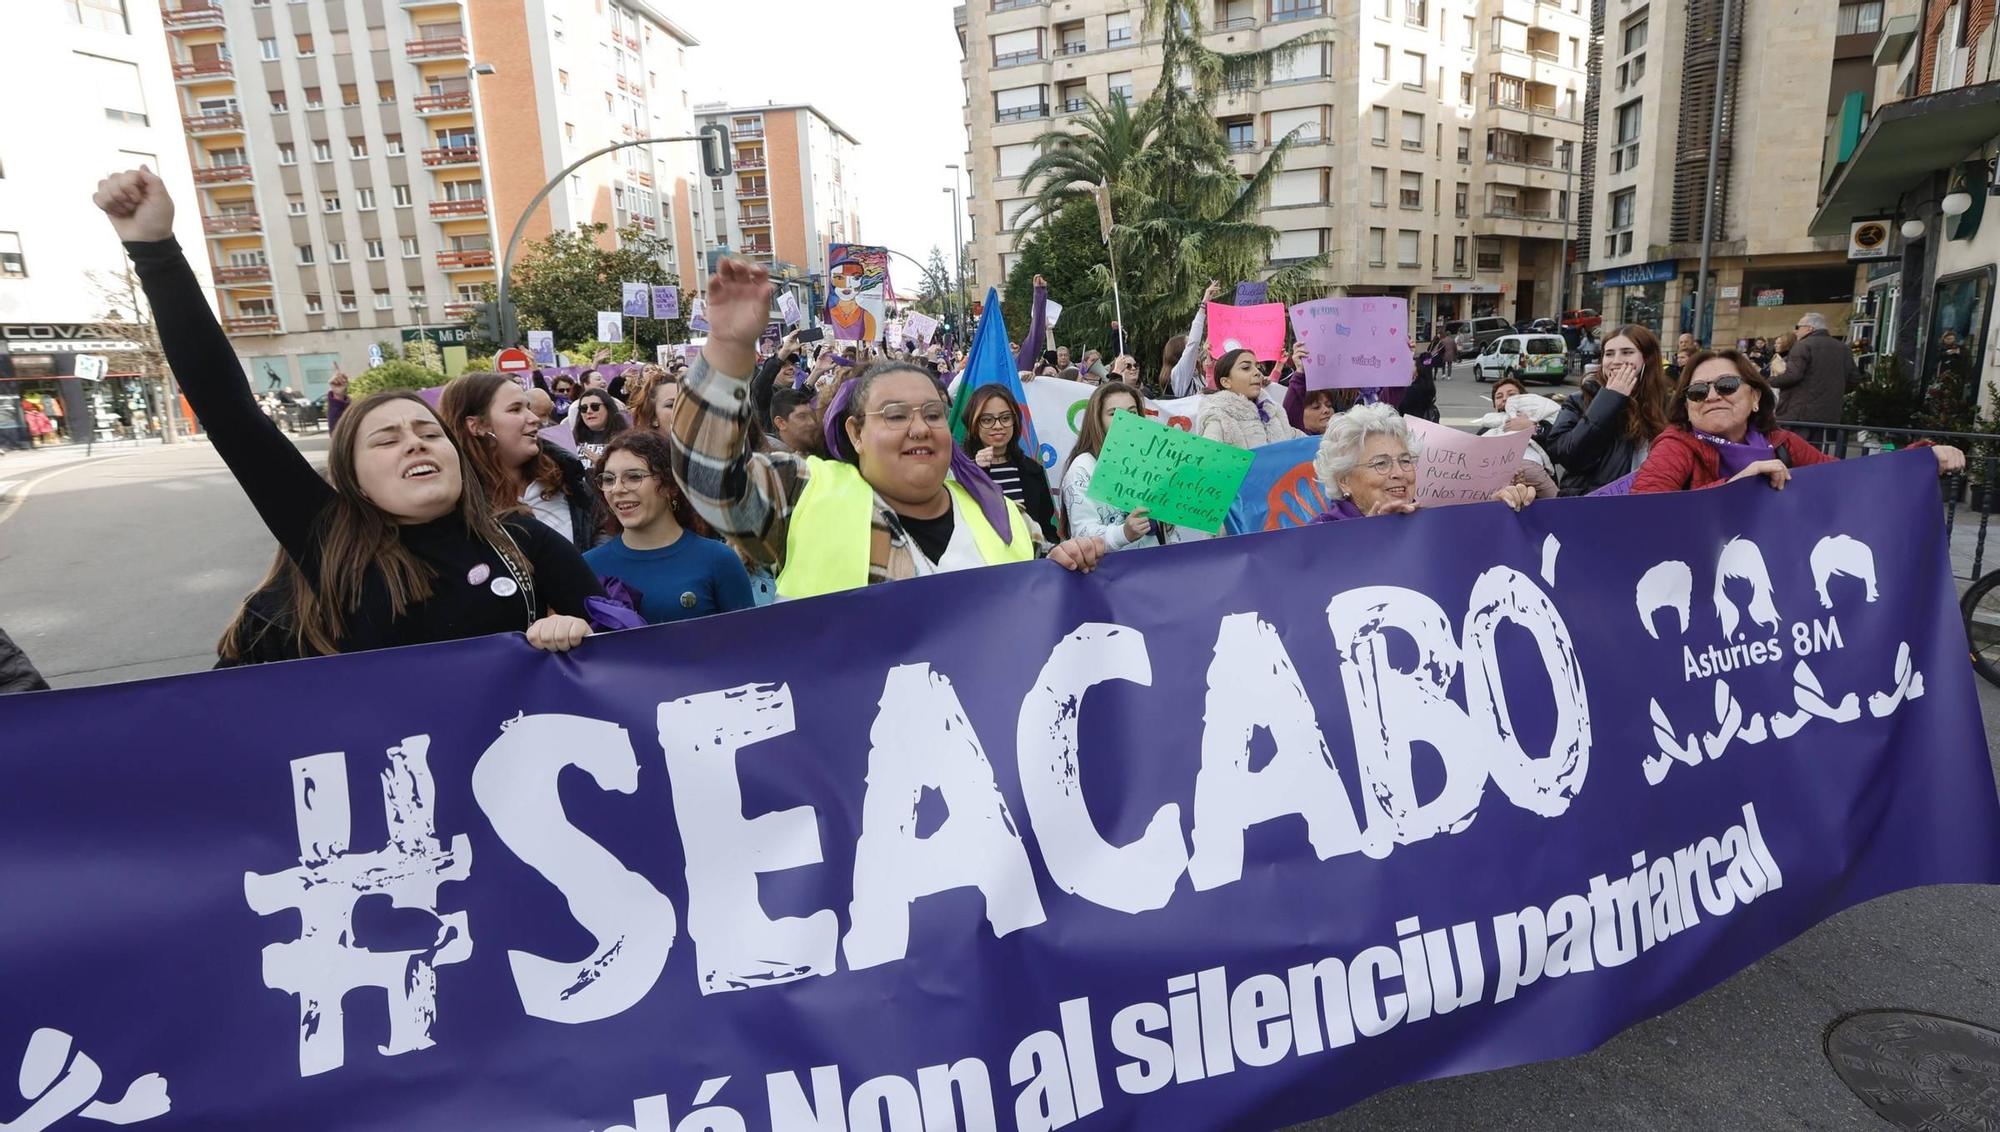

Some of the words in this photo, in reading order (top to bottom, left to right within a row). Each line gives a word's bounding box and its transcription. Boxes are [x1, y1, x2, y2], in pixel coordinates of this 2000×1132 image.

[439, 330, 453, 341] Mi
[1140, 434, 1205, 468] Mujer
[1500, 448, 1516, 465] NO
[1119, 456, 1139, 479] Si
[1142, 469, 1164, 485] no
[1168, 470, 1222, 501] luchas
[1431, 486, 1456, 499] NOS
[1683, 633, 1783, 682] Asturies
[1791, 615, 1845, 657] 8M
[244, 533, 1593, 1078] #SEACABÓ
[1010, 996, 1104, 1132] al
[1111, 915, 1485, 1094] silenciu
[1493, 802, 1784, 1004] patriarcal
